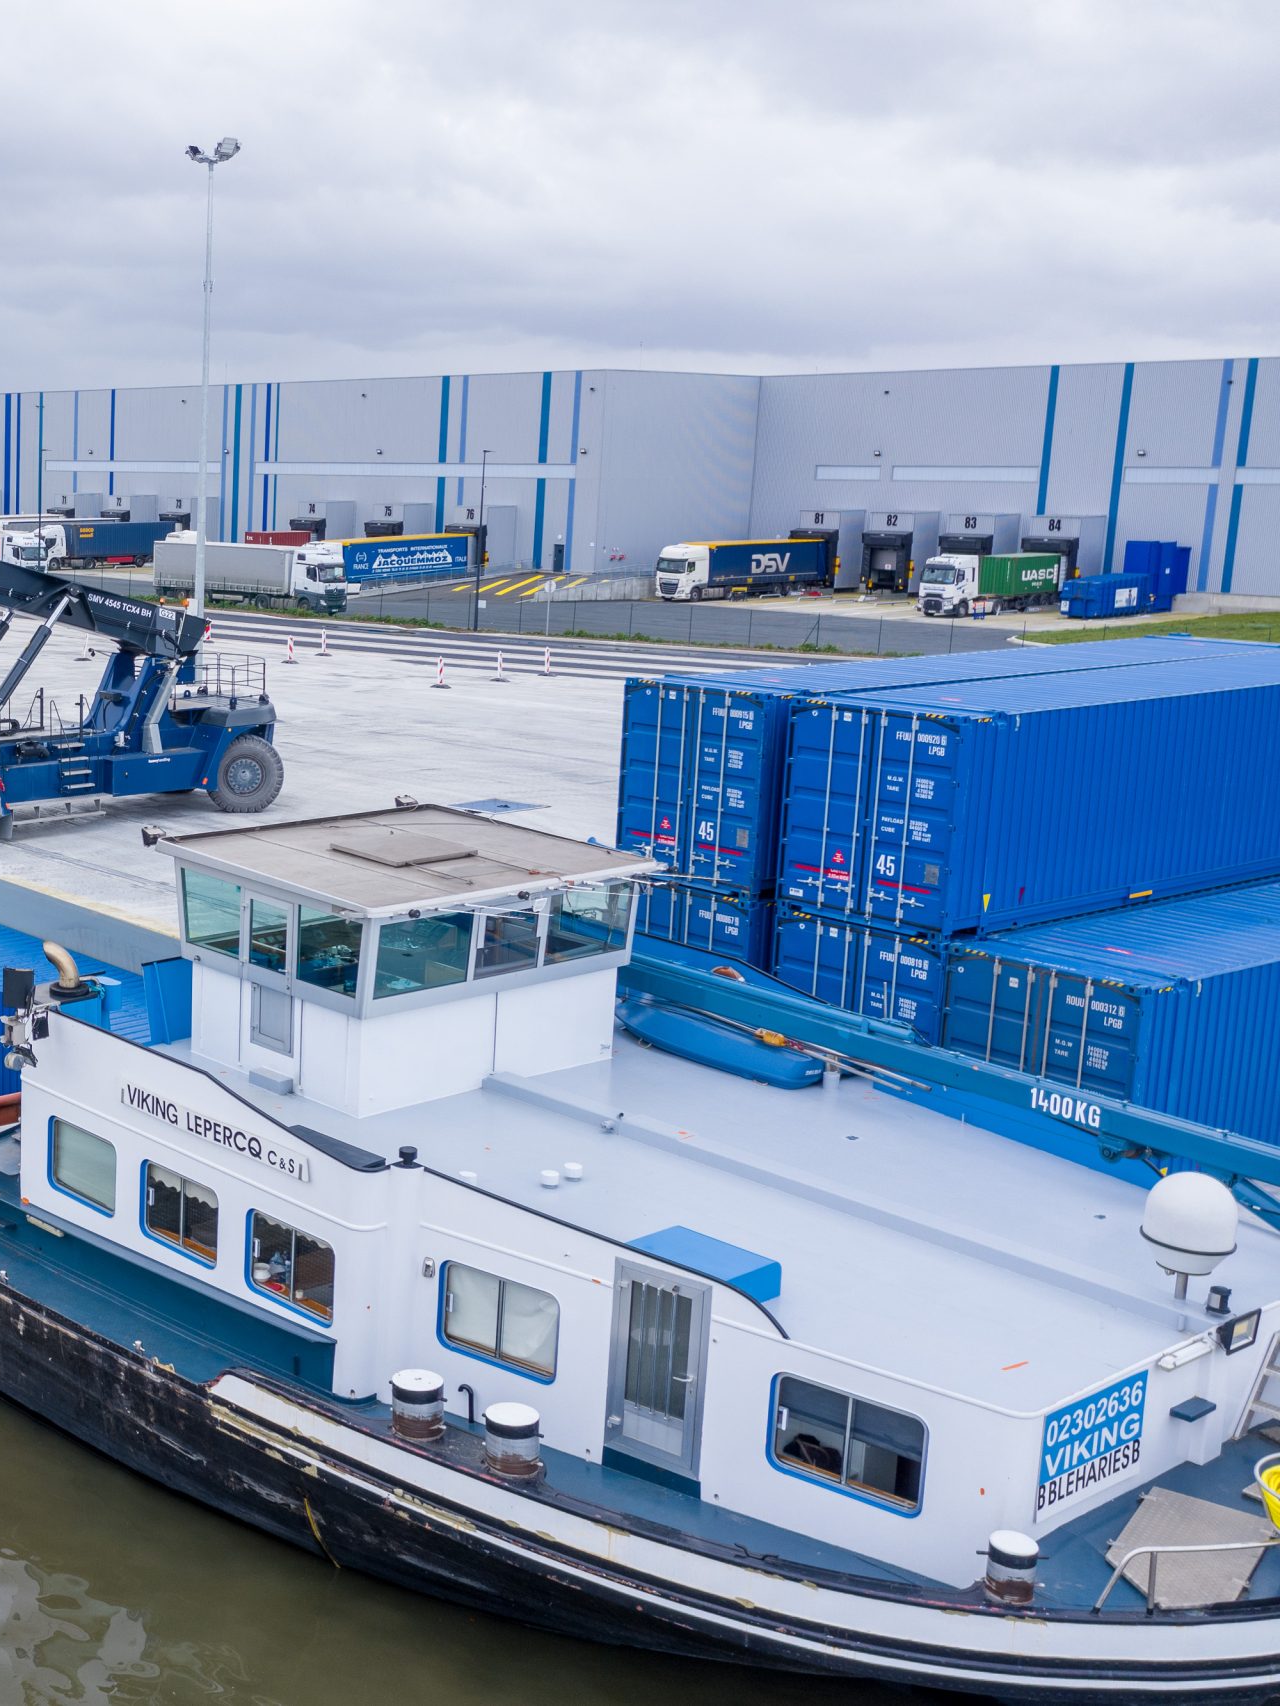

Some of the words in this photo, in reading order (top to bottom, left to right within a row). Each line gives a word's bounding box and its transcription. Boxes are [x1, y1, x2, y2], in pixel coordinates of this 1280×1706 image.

[308, 504, 316, 514] 74
[384, 506, 392, 516] 75
[466, 508, 474, 520] 76
[814, 512, 824, 525] 81
[886, 514, 898, 527] 82
[964, 516, 977, 529] 83
[1048, 518, 1061, 532] 84
[378, 546, 408, 554] TRANSPORTS
[377, 554, 449, 567] JACQUEMMOZ
[751, 552, 791, 574] DSV
[1022, 568, 1054, 582] UASC
[88, 593, 105, 604] SMV
[104, 598, 121, 610] 4545
[140, 608, 152, 618] BH
[917, 733, 940, 745] 000920
[928, 746, 945, 756] LPGB
[886, 784, 900, 792] TARE
[881, 816, 904, 825] PAYLOAD
[698, 820, 714, 841] 45
[880, 826, 896, 834] CUBE
[876, 854, 896, 877] 45
[910, 968, 928, 980] LPGB
[1066, 994, 1085, 1008] ROUU
[1090, 1000, 1117, 1016] 000312
[1104, 1016, 1122, 1030] LPGB
[1054, 1048, 1069, 1058] TARE
[127, 1084, 178, 1125] VIKING
[187, 1112, 262, 1160] LEPERCQ
[1046, 1380, 1144, 1447] 02302636
[1045, 1412, 1140, 1478] VIKING
